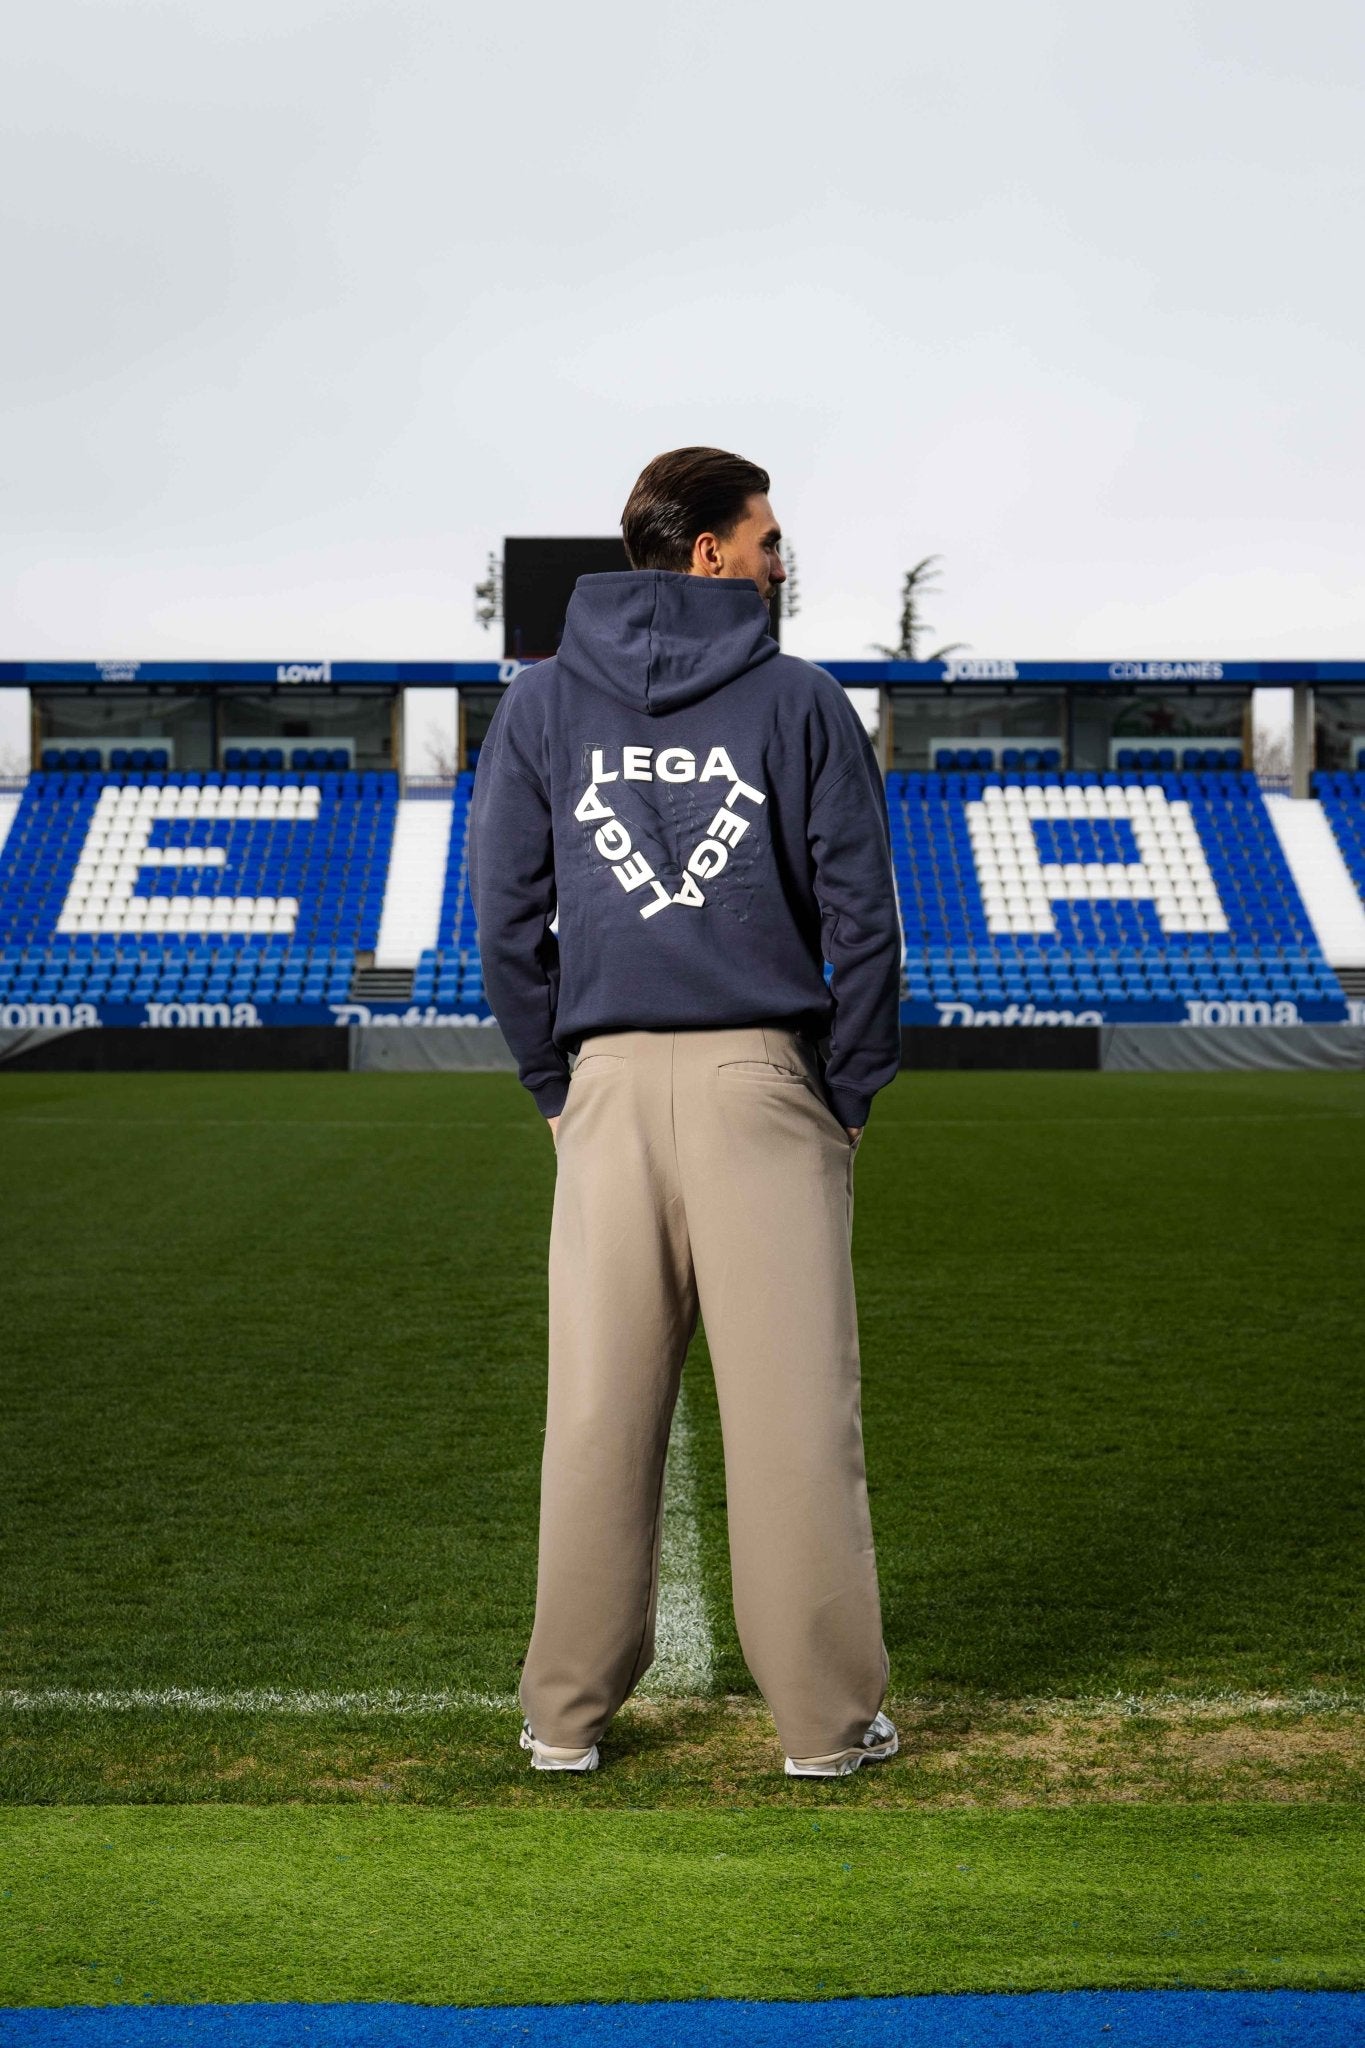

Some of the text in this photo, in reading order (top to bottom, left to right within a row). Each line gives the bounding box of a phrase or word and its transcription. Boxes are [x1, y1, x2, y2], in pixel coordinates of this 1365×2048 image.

[592, 747, 739, 784] LEGA
[56, 785, 321, 934] E
[574, 783, 672, 919] LEGA
[672, 779, 766, 908] LEGA
[965, 785, 1230, 934] A
[0, 1003, 103, 1028] oma
